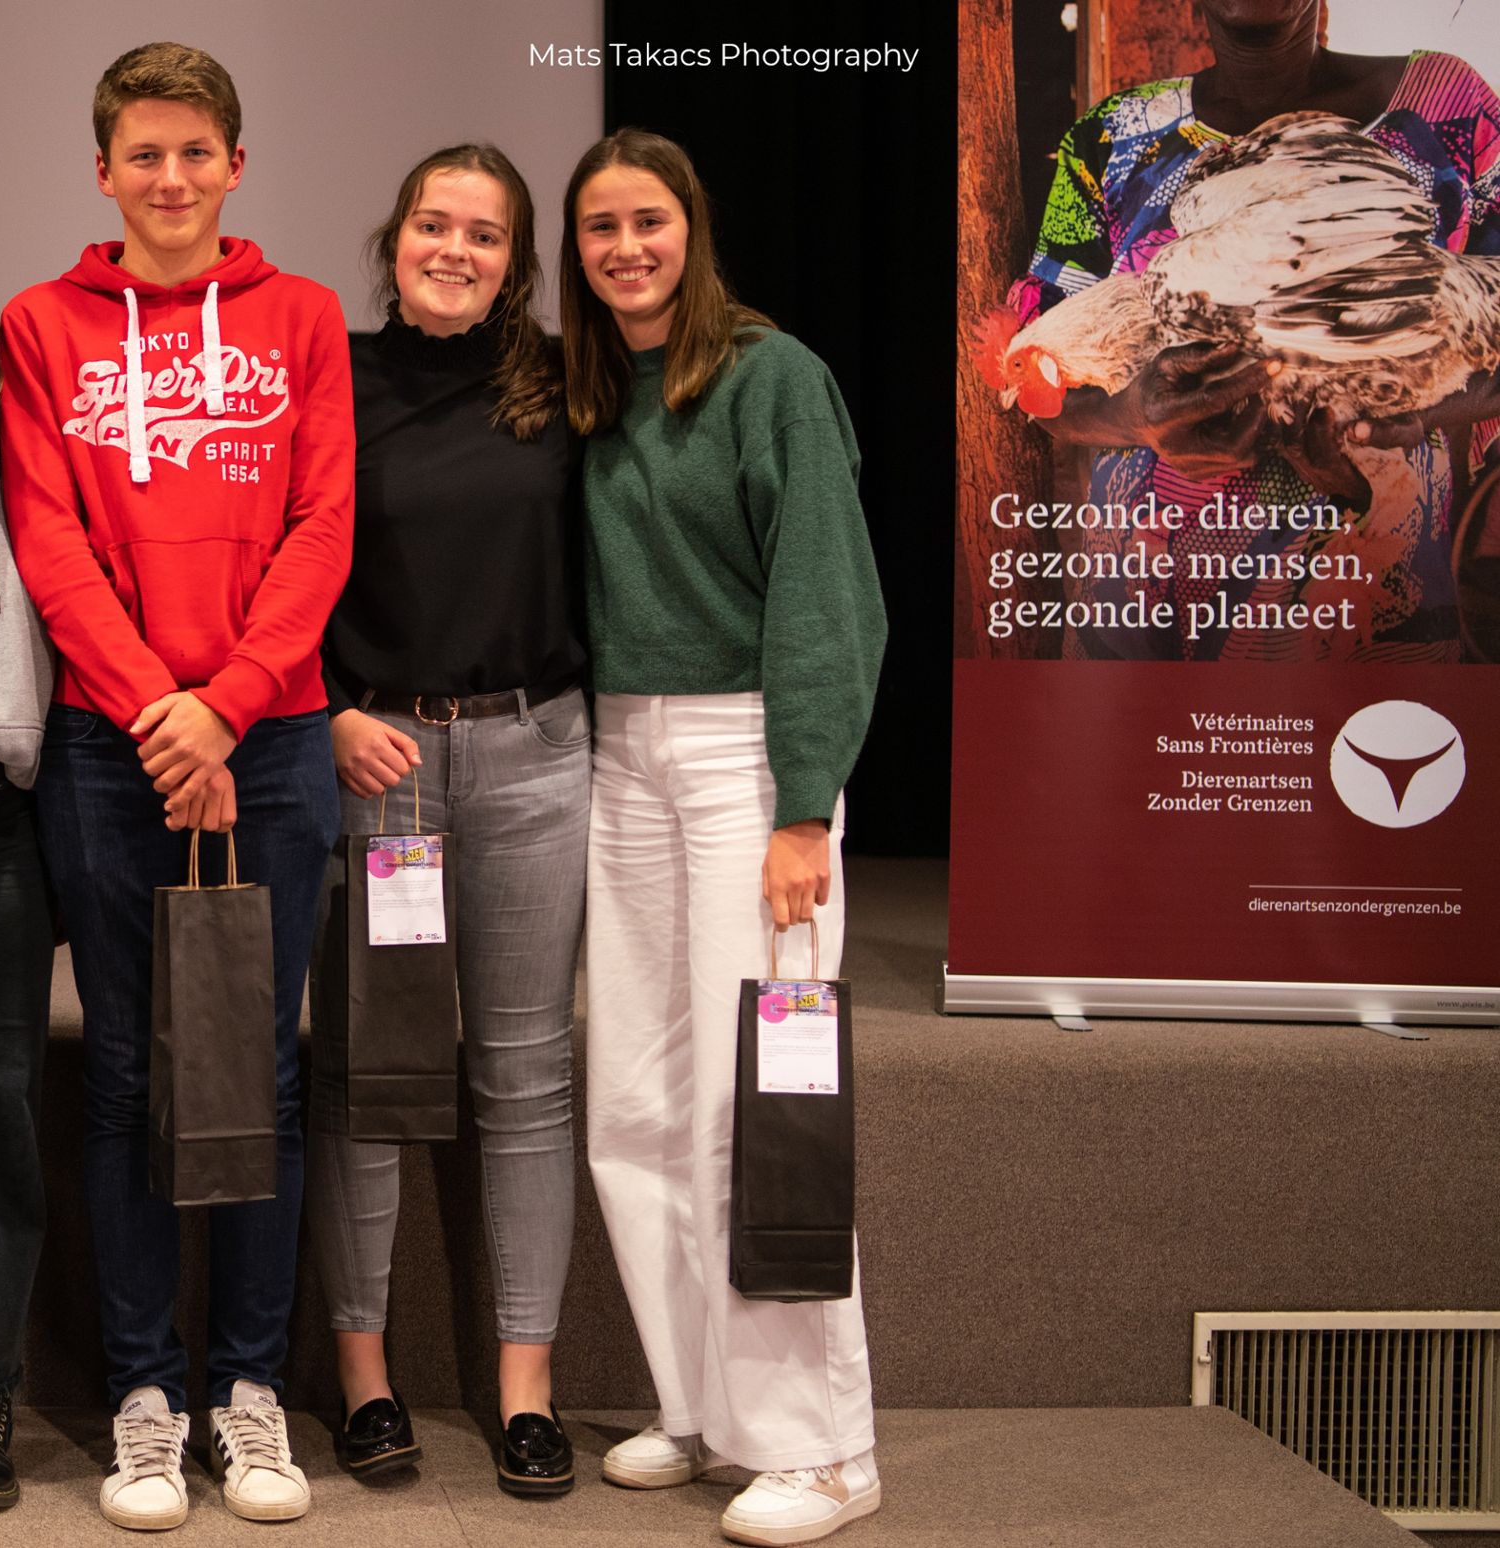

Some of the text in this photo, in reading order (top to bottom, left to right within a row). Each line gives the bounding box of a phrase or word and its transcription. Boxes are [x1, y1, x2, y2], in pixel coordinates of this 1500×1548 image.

[226, 397, 260, 415] EAL
[204, 441, 276, 462] SPIRIT
[221, 464, 260, 483] 1954
[989, 492, 1353, 536] Gezonde dieren,
[987, 541, 1374, 590] gezonde mensen,
[987, 590, 1356, 641] gezonde planeet
[1190, 713, 1315, 732] Vétérinaires
[1156, 735, 1315, 755] Sans Frontières
[1181, 770, 1313, 790] Dierenartsen
[1147, 793, 1313, 813] Zonder Grenzen
[1248, 898, 1463, 917] dierenartsenzondergrenzen.be
